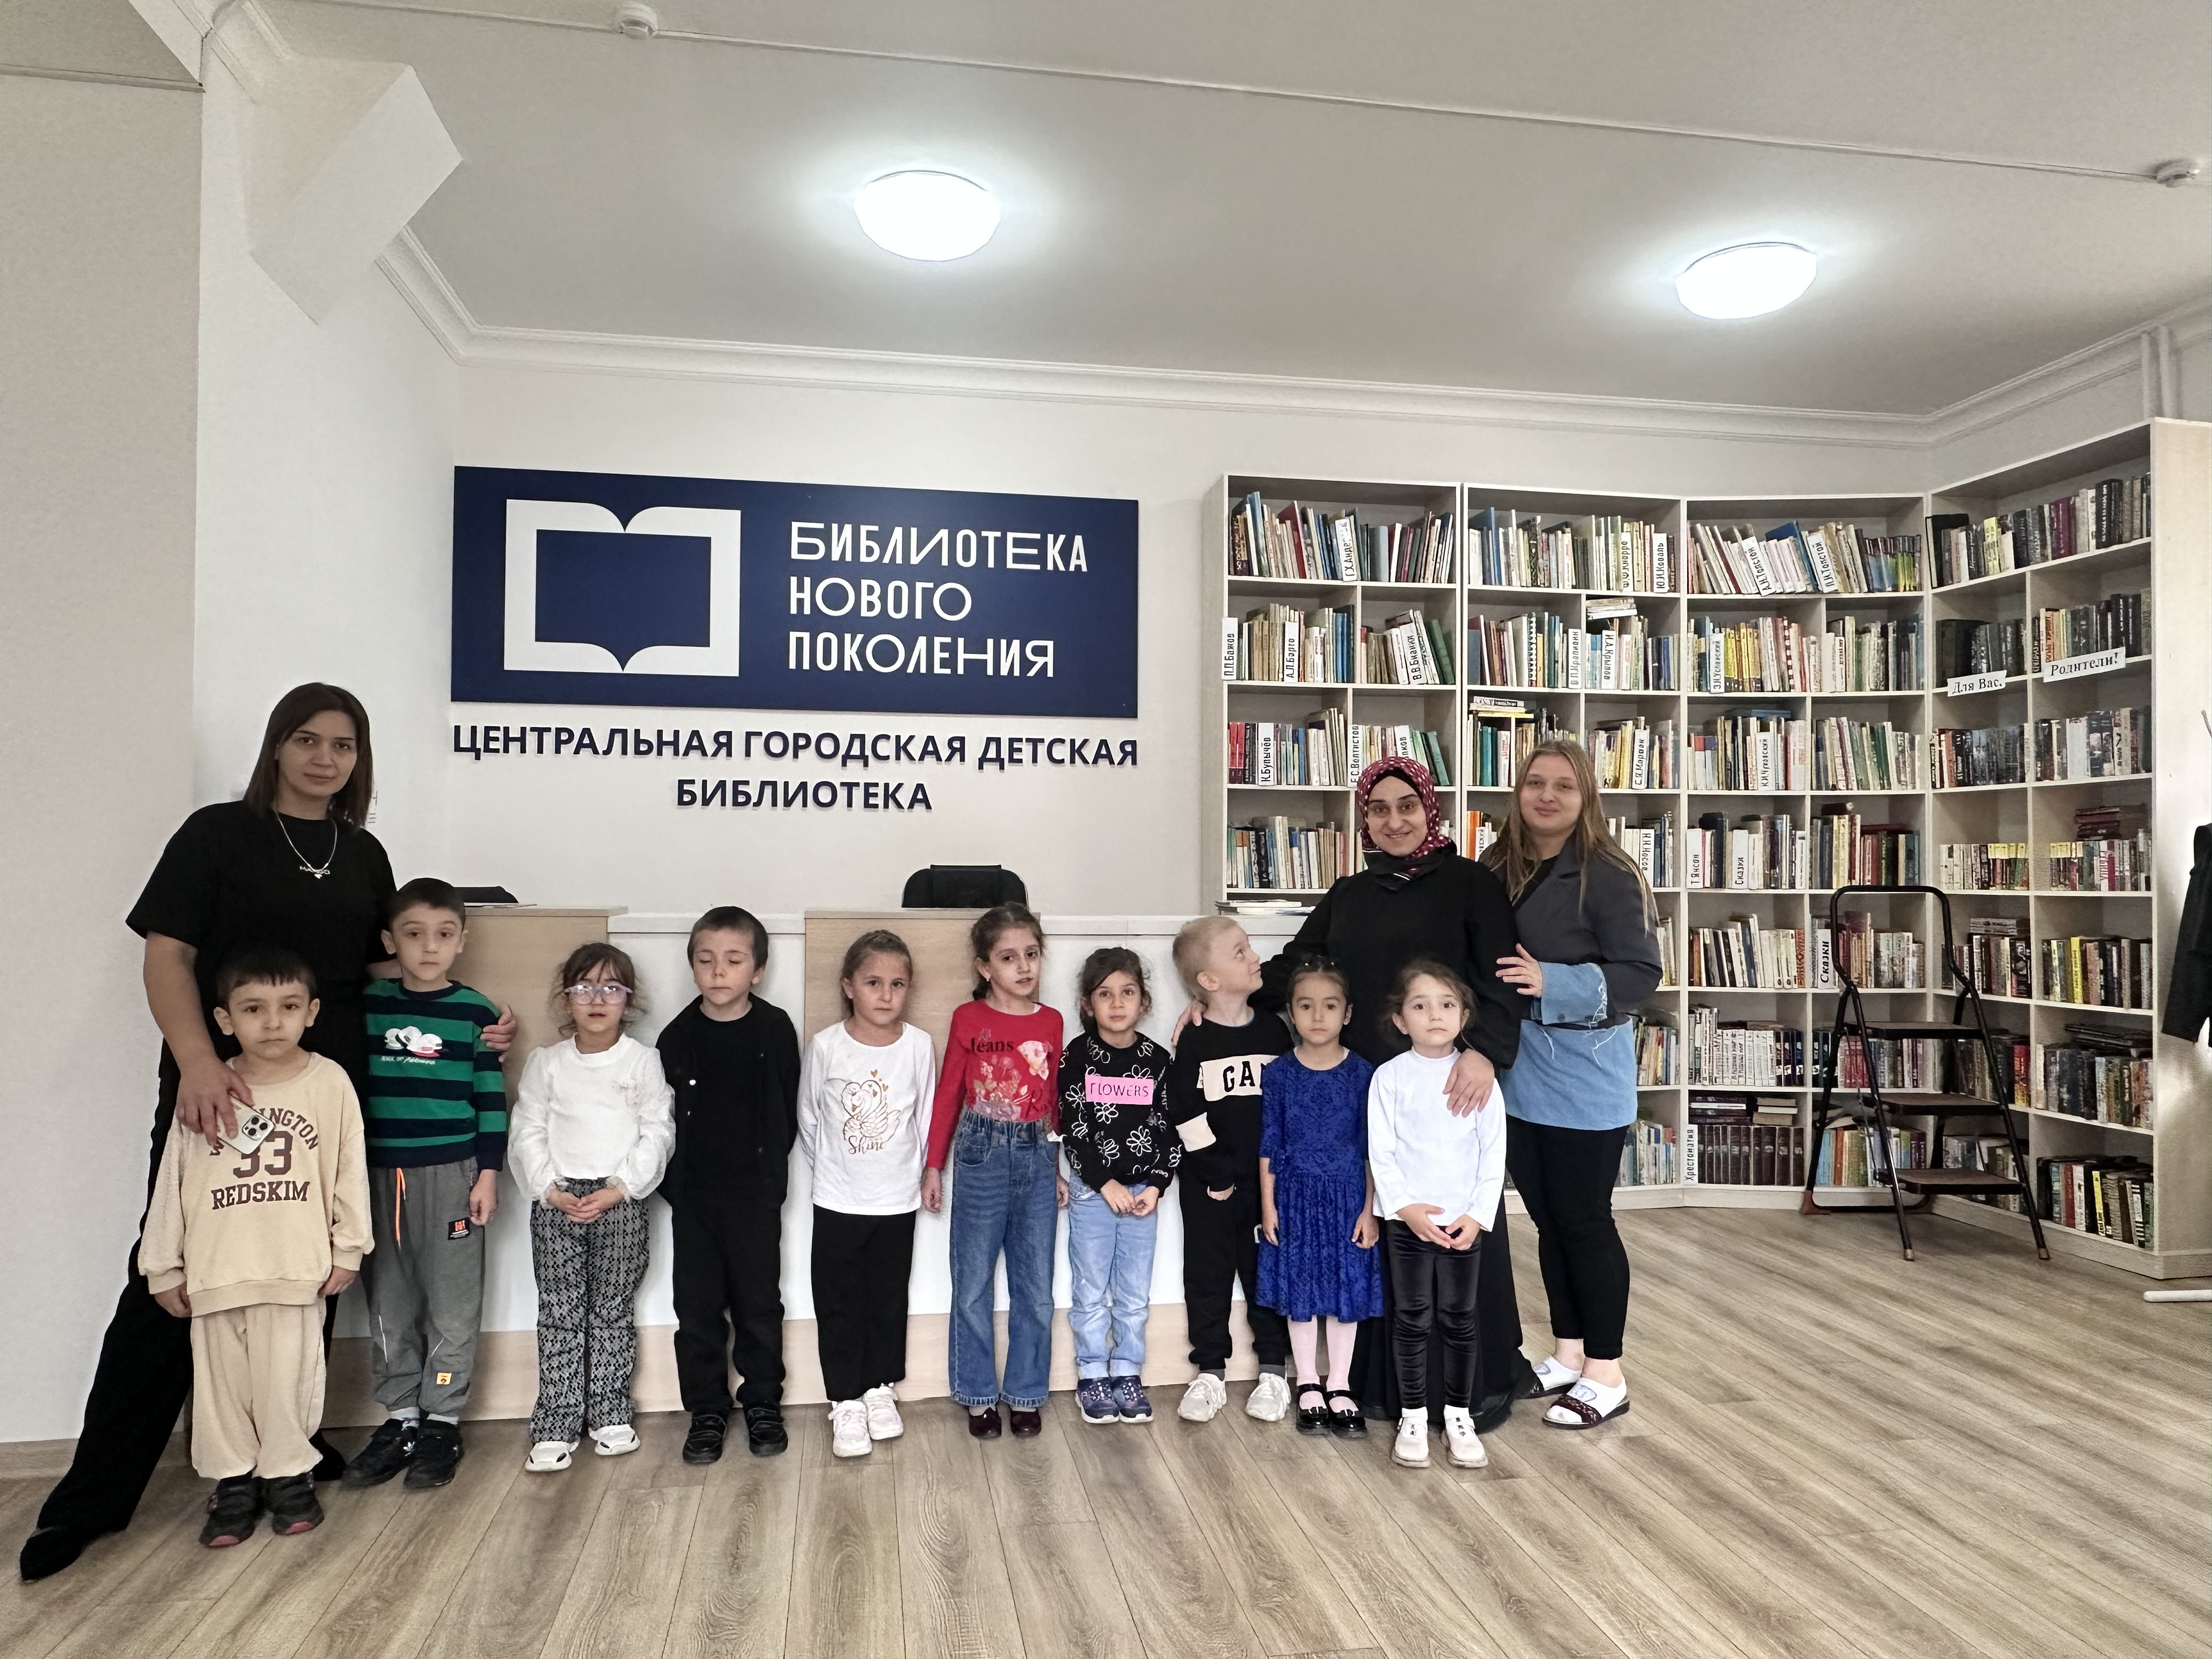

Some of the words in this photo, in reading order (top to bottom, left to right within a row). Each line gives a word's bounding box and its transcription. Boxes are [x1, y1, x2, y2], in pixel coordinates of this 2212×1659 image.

[791, 521, 1087, 572] БИБЛИОТЕКА
[790, 576, 972, 621] НОВОГО
[789, 631, 1054, 678] ПОКОЛЕНИЯ
[2050, 652, 2119, 677] Родители!
[1951, 682, 1974, 695] Для
[454, 725, 732, 761] ЦЕНТРАЛЬНАЯ
[744, 731, 966, 768] ГОРОДСКАЯ
[978, 737, 1138, 771] ДЕТСКАЯ
[676, 779, 932, 810] БИБЛИОТЕКА
[1820, 940, 1829, 983] Сказки
[1091, 1082, 1149, 1097] FLOWERS
[1222, 1060, 1265, 1093] GA
[233, 1130, 293, 1179] 33
[211, 1180, 311, 1210] REDSKIM
